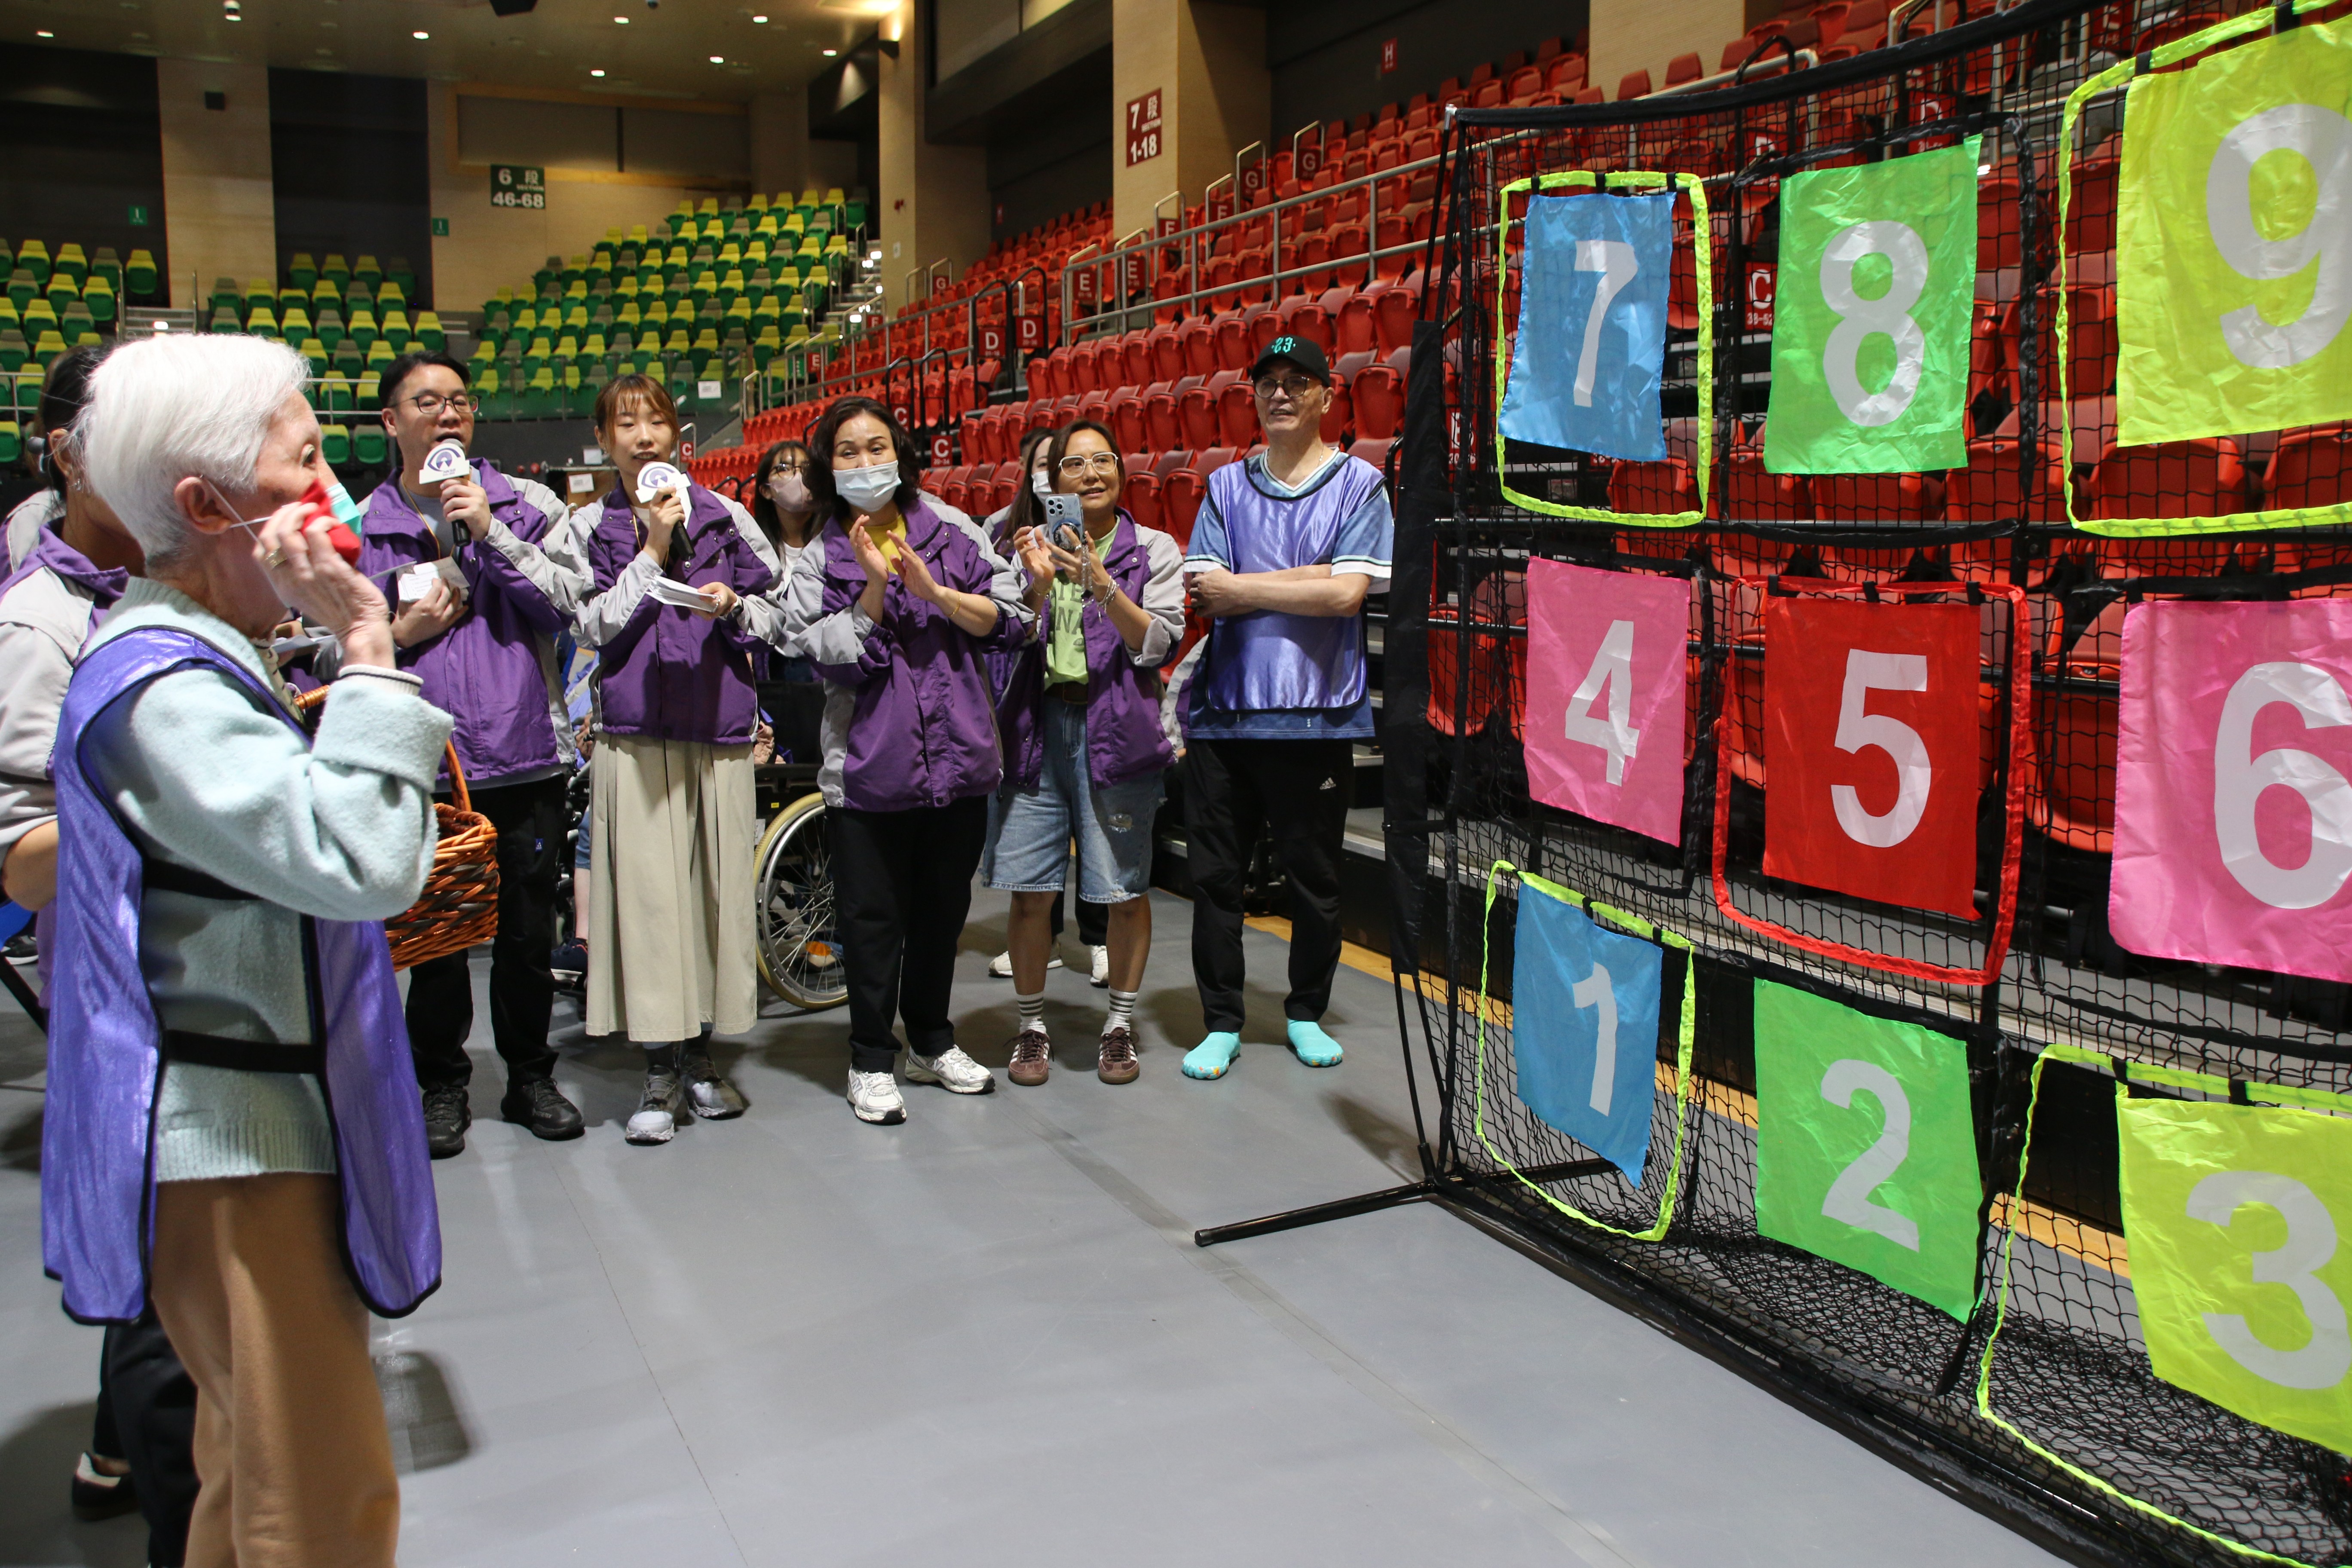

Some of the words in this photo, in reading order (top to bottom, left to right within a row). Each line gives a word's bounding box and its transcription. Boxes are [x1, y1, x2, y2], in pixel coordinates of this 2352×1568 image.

[1385, 44, 1393, 62] H
[1130, 103, 1140, 130] 7
[1130, 134, 1157, 162] 1-18
[1303, 153, 1316, 171] G
[499, 168, 512, 185] 6
[1246, 171, 1259, 188] G
[493, 192, 544, 208] 46-68
[1165, 221, 1175, 237] F
[2206, 104, 2352, 368] 9
[1128, 261, 1137, 279] E
[937, 278, 946, 290] G
[1080, 274, 1090, 290] E
[1749, 269, 1772, 309] C
[1023, 319, 1036, 338] D
[1574, 240, 1638, 407] 7
[1820, 220, 1929, 426] 8
[985, 332, 998, 350] D
[812, 354, 820, 367] E
[894, 407, 907, 425] C
[682, 443, 692, 456] C
[934, 439, 949, 458] C
[1565, 619, 1640, 787] 4
[1831, 649, 1931, 848] 5
[2214, 662, 2352, 910] 6
[1572, 961, 1618, 1117] 1
[1821, 1059, 1920, 1253] 2
[2186, 1171, 2352, 1390] 3
